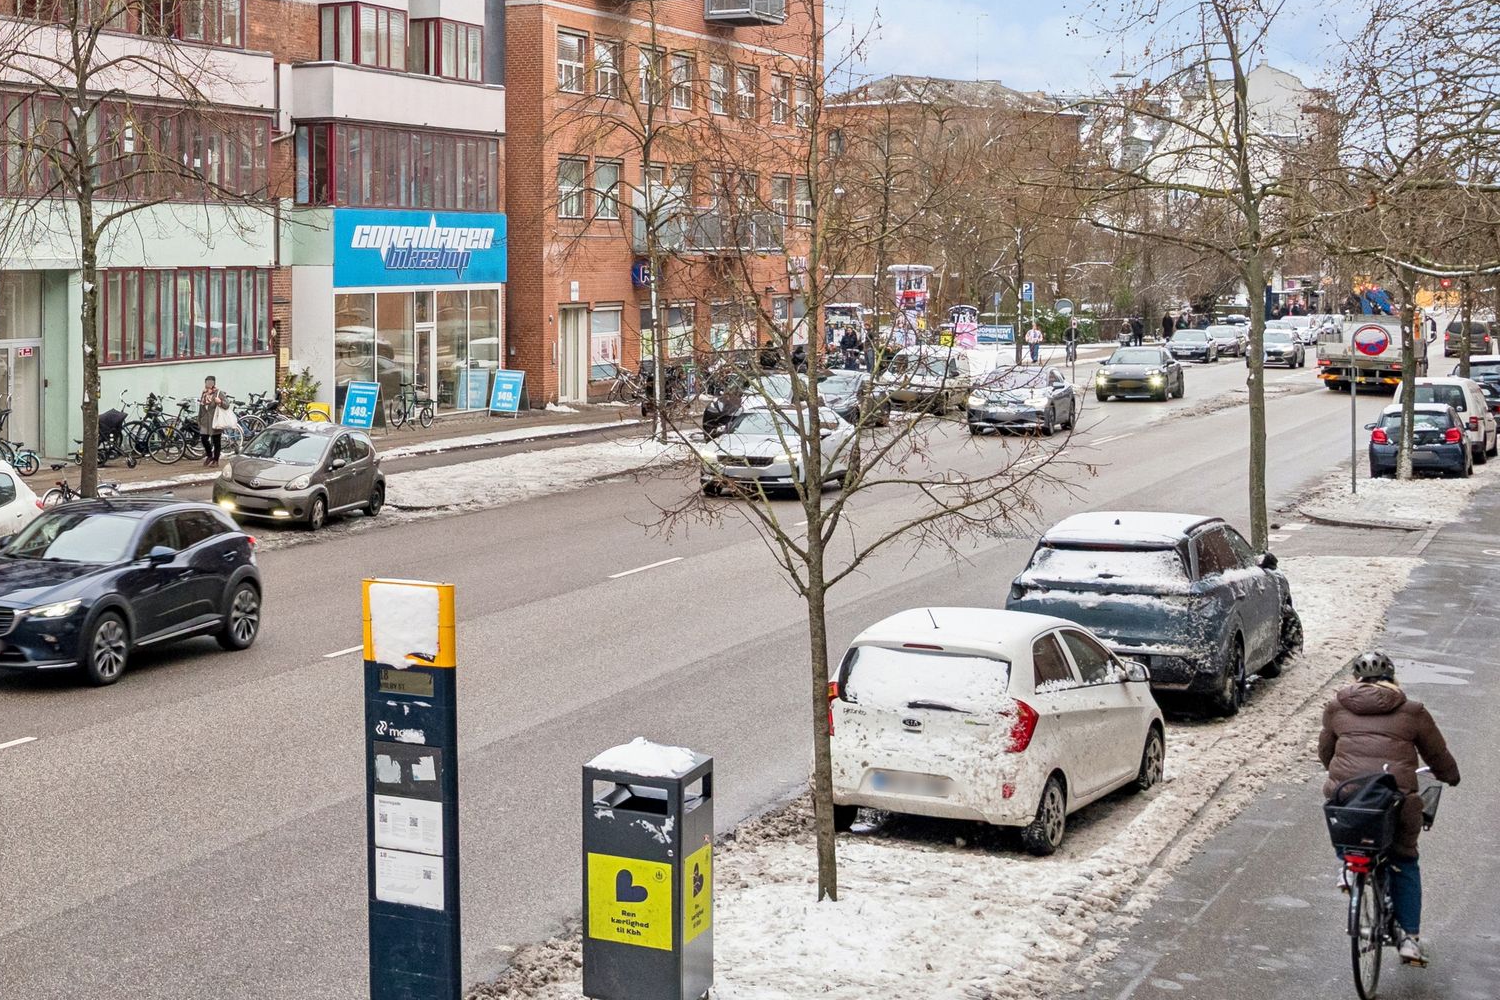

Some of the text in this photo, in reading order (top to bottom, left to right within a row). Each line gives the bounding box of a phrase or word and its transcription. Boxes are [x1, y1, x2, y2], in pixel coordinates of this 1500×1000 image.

[351, 213, 495, 263] copenhagen
[384, 241, 472, 280] bikeshop
[1023, 283, 1030, 292] P
[611, 917, 649, 928] kærlighed
[626, 928, 642, 936] Kbh
